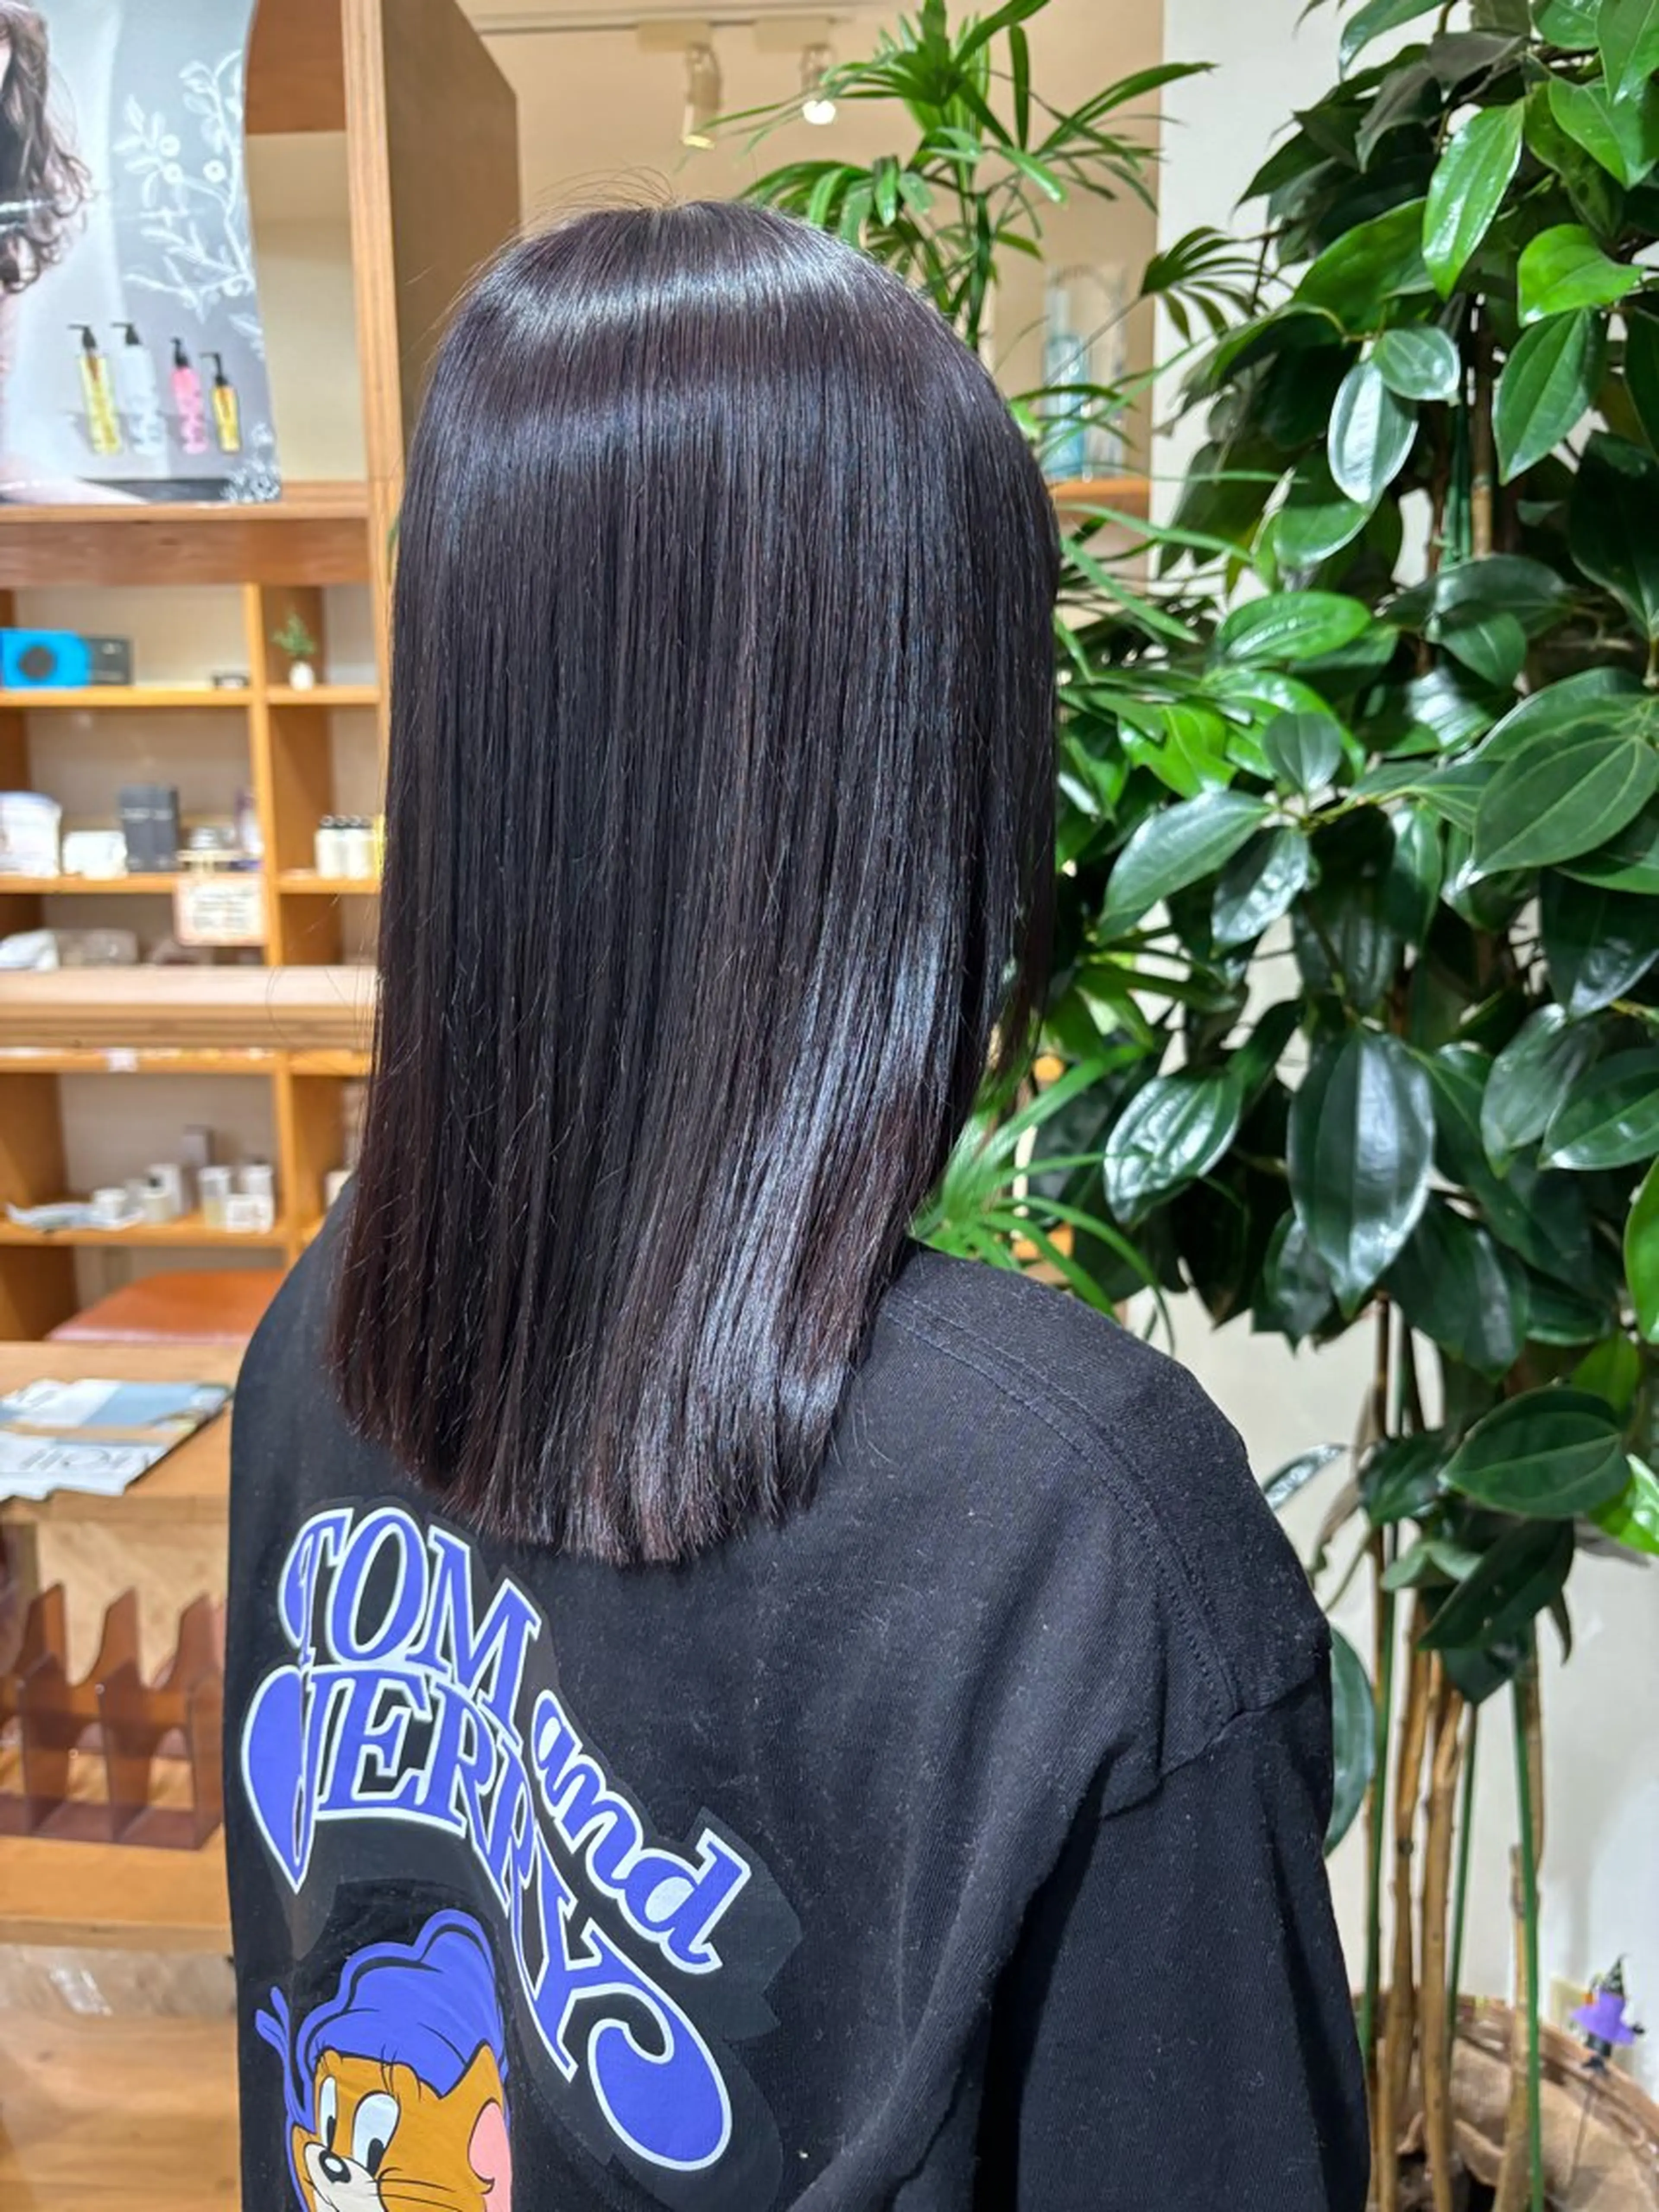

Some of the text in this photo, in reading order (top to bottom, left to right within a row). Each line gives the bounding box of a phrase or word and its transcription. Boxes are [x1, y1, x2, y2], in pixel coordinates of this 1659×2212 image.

[242, 1665, 732, 2171] JERRY
[278, 1507, 751, 1974] TOM and
